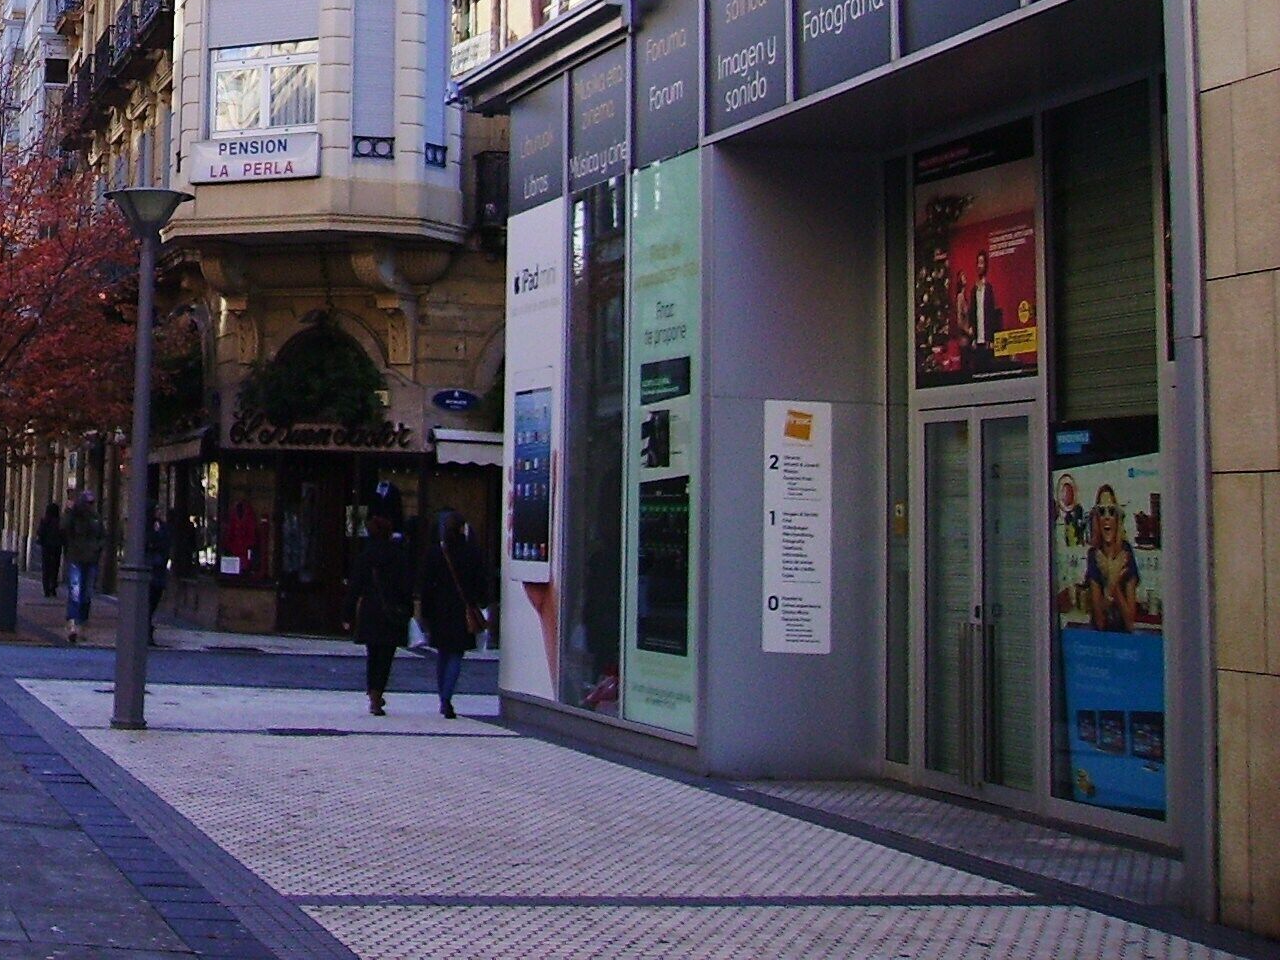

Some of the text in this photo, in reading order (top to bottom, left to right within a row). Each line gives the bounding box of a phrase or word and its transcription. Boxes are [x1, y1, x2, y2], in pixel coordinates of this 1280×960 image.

[717, 35, 777, 80] Imagen y
[649, 80, 684, 113] Forum
[725, 71, 768, 113] sonido
[218, 138, 288, 156] PENSION
[209, 160, 294, 179] LA PERLA
[769, 454, 779, 470] 2
[769, 510, 776, 526] 1
[768, 595, 779, 611] 0
